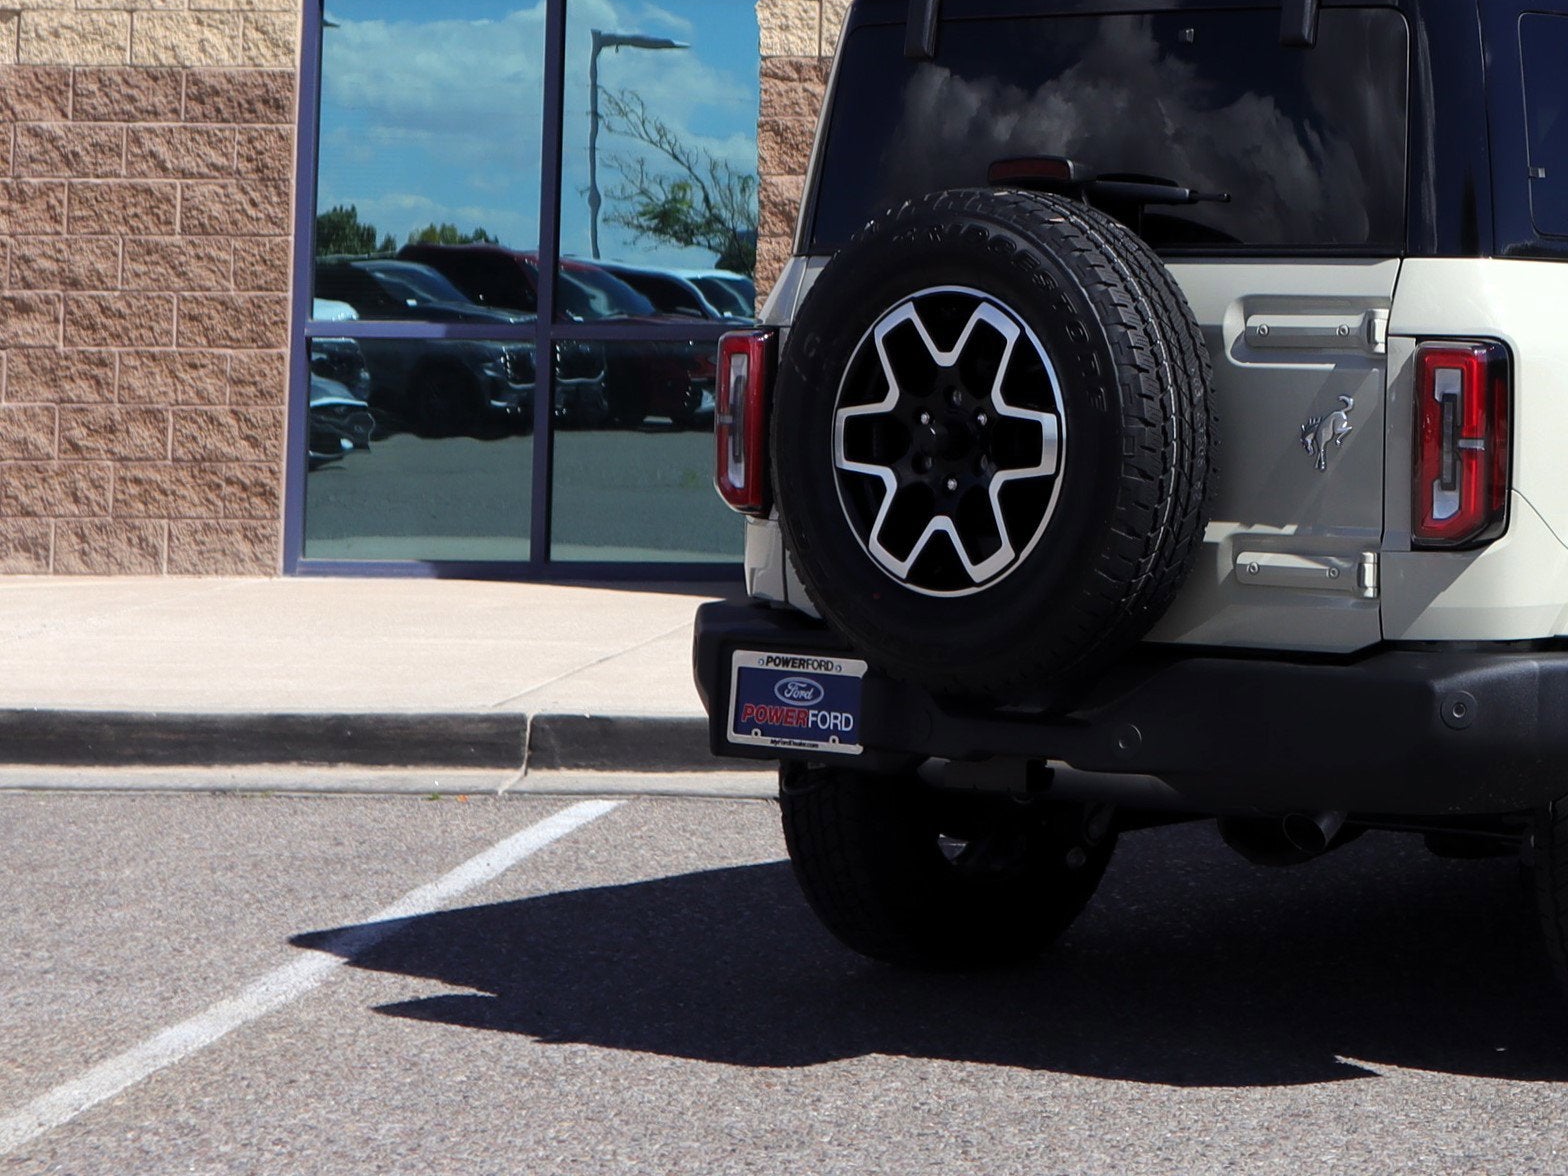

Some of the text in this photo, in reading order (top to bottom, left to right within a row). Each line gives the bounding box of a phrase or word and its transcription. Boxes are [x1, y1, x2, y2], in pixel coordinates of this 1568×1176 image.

[765, 656, 834, 672] POWERFORD
[783, 679, 814, 701] Ford
[741, 703, 854, 732] POWERFORD
